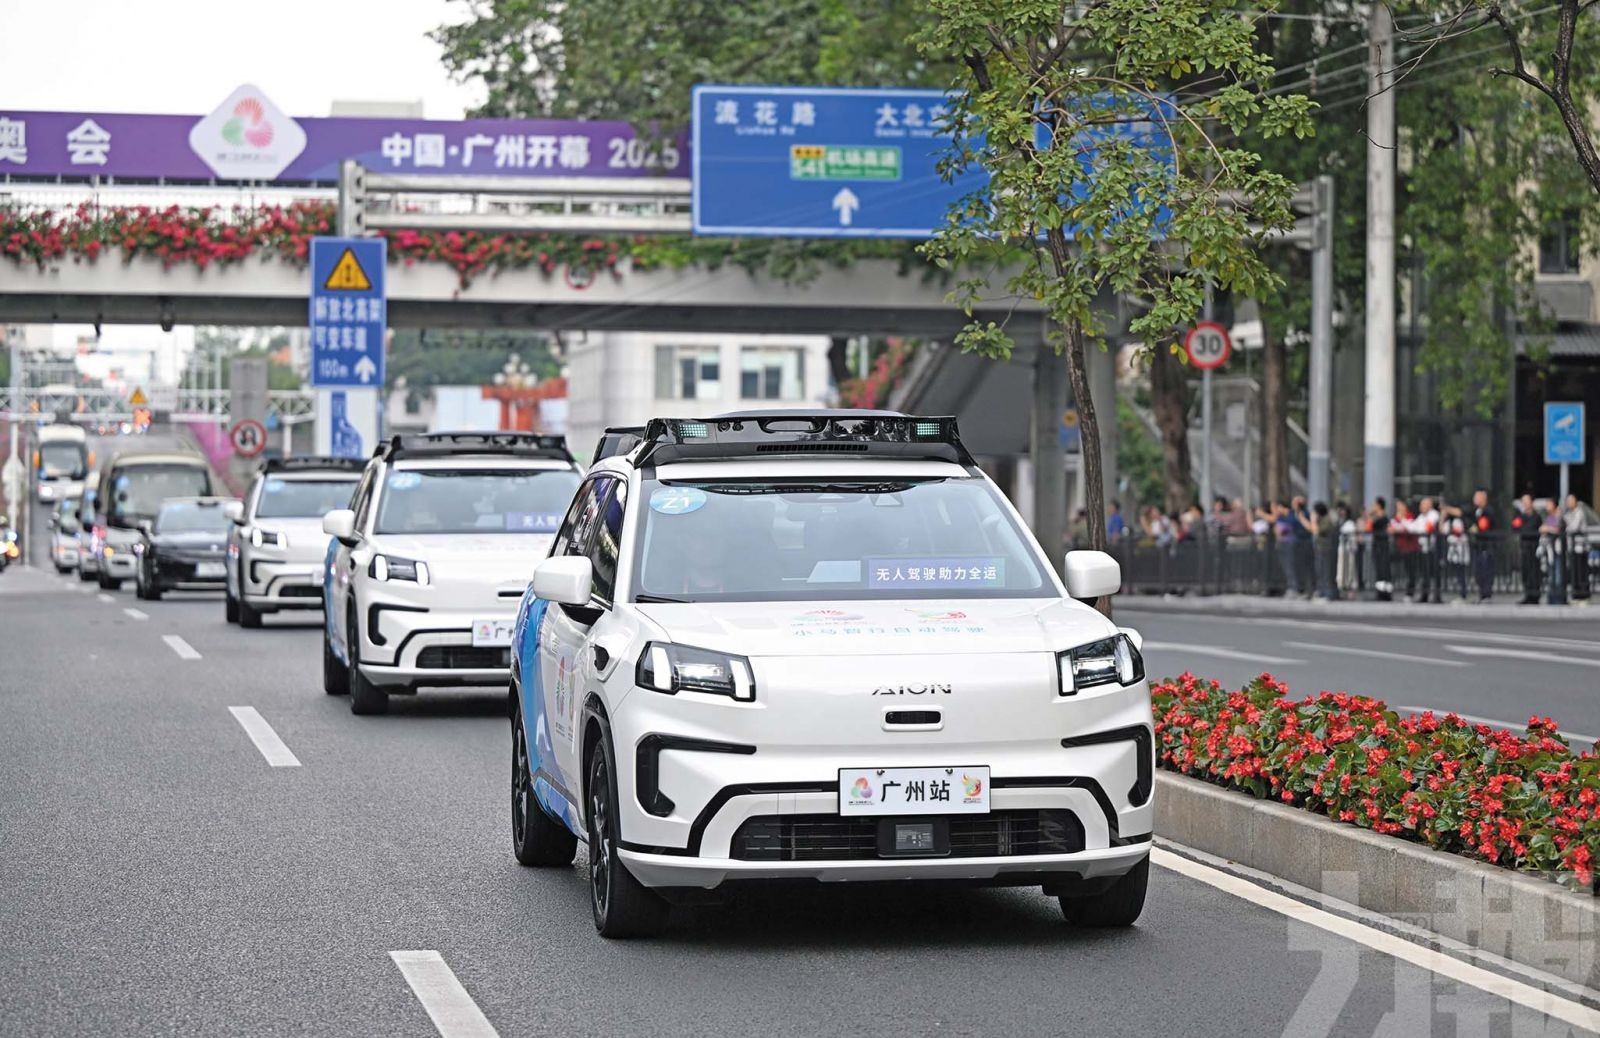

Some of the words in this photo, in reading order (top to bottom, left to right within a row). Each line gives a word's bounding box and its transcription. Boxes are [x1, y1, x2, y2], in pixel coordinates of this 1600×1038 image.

[876, 103, 952, 127] 大北立
[381, 132, 590, 168] 中国·广州开幕
[608, 137, 680, 169] 2025
[1195, 335, 1222, 355] 30
[877, 567, 997, 581] 无人驾驶助力全运
[872, 683, 951, 695] AION
[881, 780, 950, 802] 广州站
